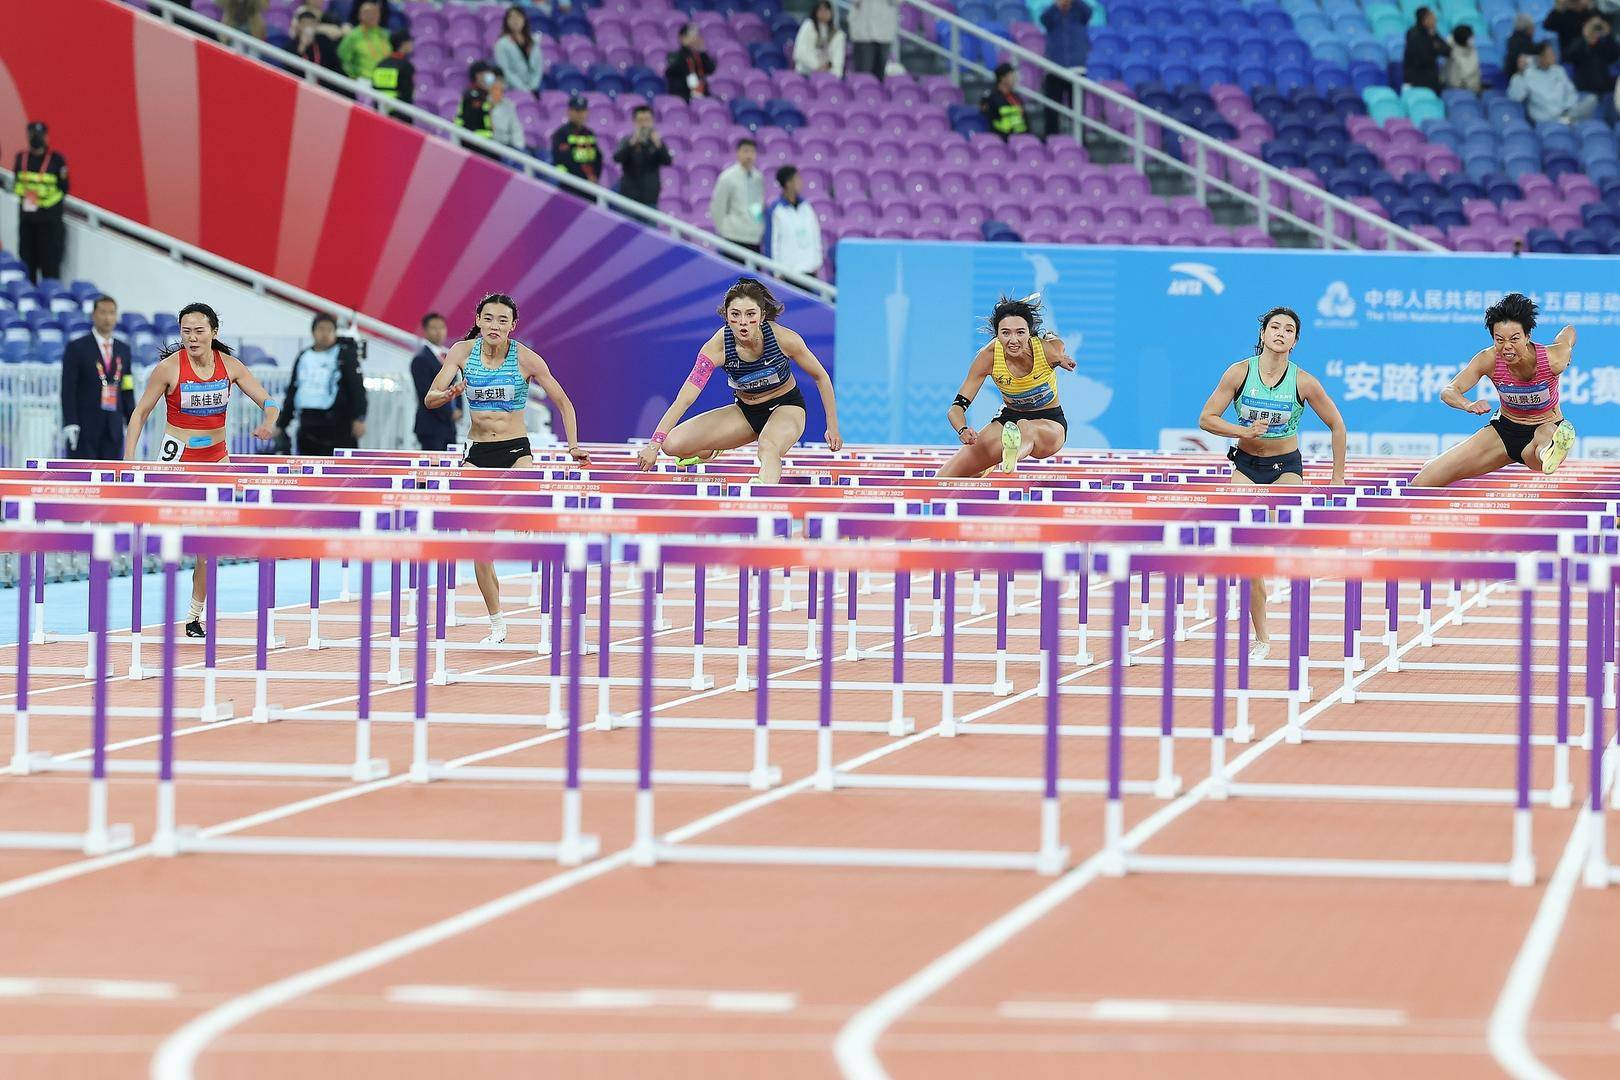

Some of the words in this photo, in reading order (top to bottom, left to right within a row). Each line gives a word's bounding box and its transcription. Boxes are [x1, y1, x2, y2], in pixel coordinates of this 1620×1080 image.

[1365, 289, 1620, 312] 中华人民共和国五届运动
[190, 393, 223, 407] 陈佳敏
[474, 387, 506, 400] 吴安琪
[162, 440, 178, 461] 9
